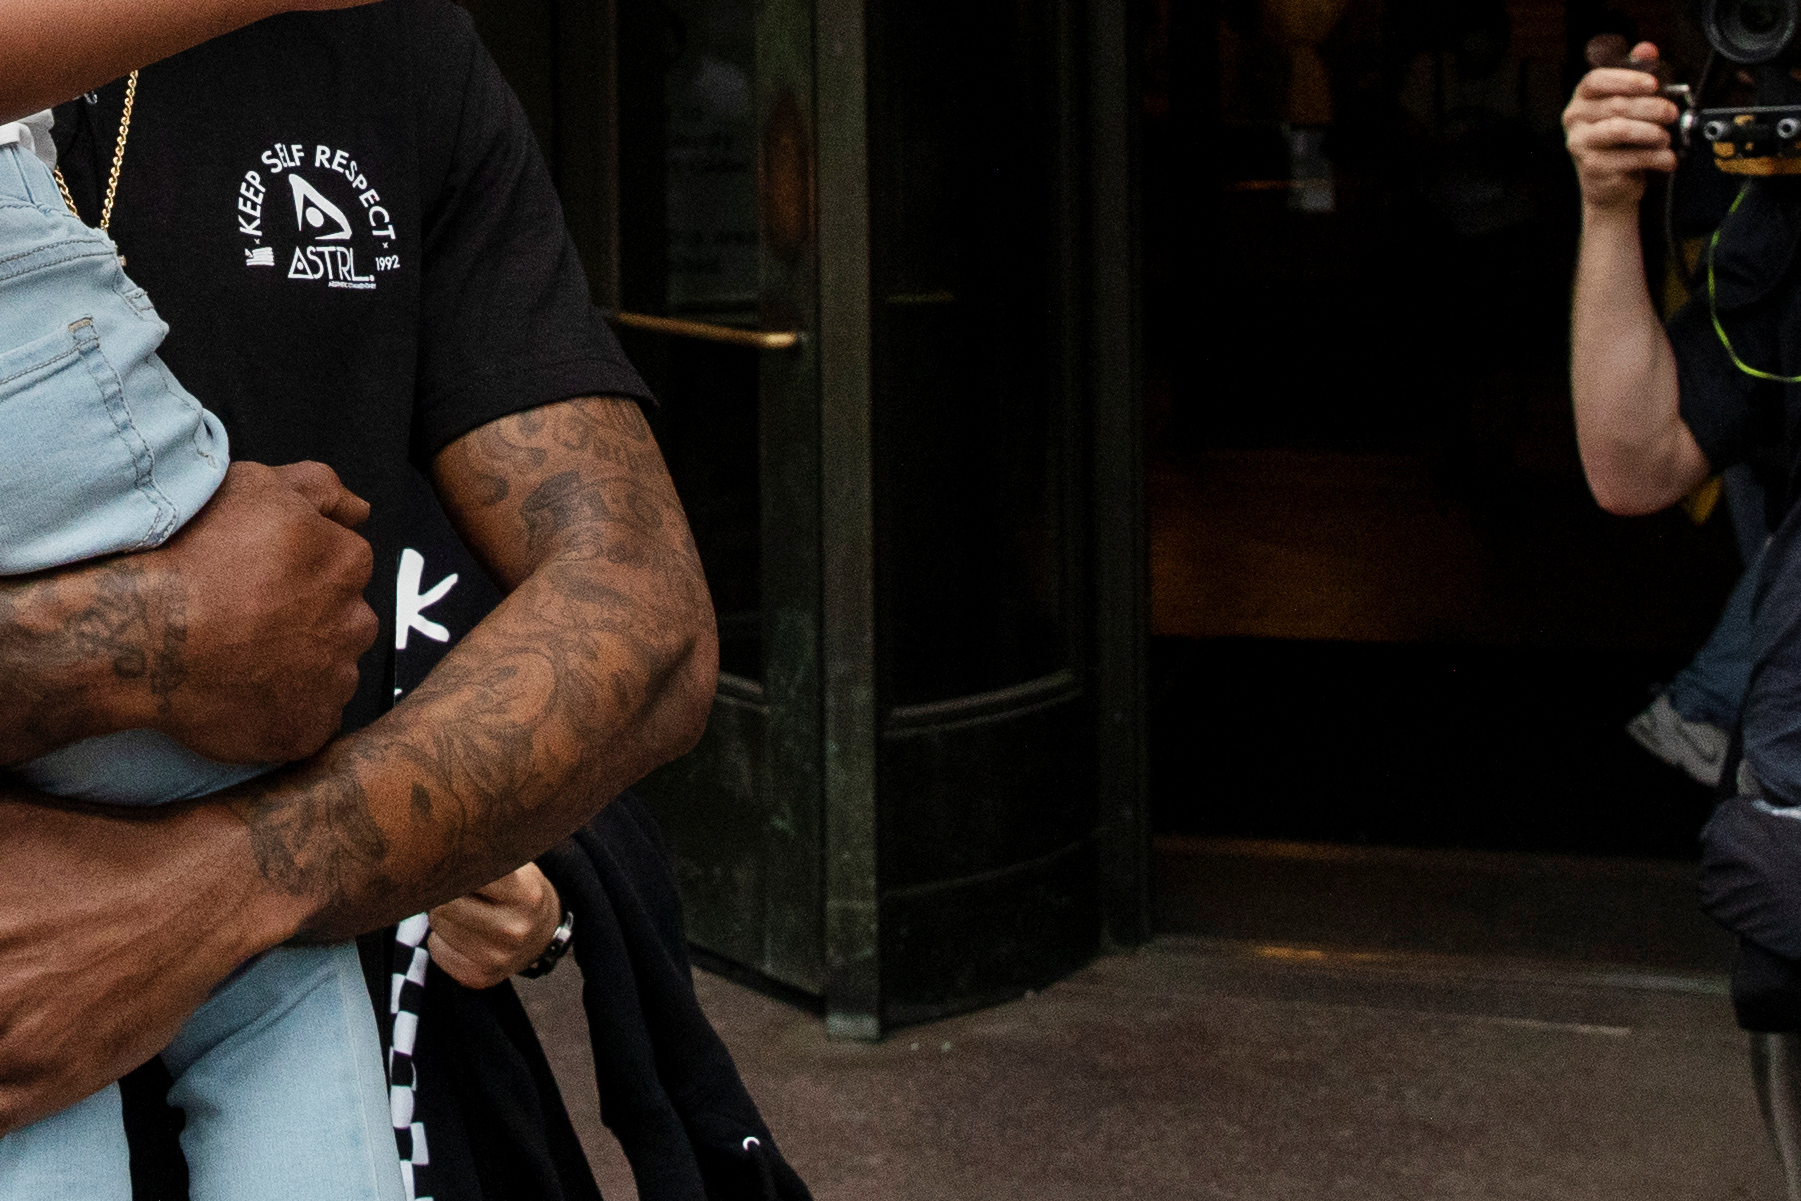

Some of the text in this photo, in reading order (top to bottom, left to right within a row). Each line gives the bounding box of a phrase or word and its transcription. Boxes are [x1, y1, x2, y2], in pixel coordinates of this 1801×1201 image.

[237, 142, 397, 240] KEEP SELF RESPECT
[374, 254, 401, 272] 1992
